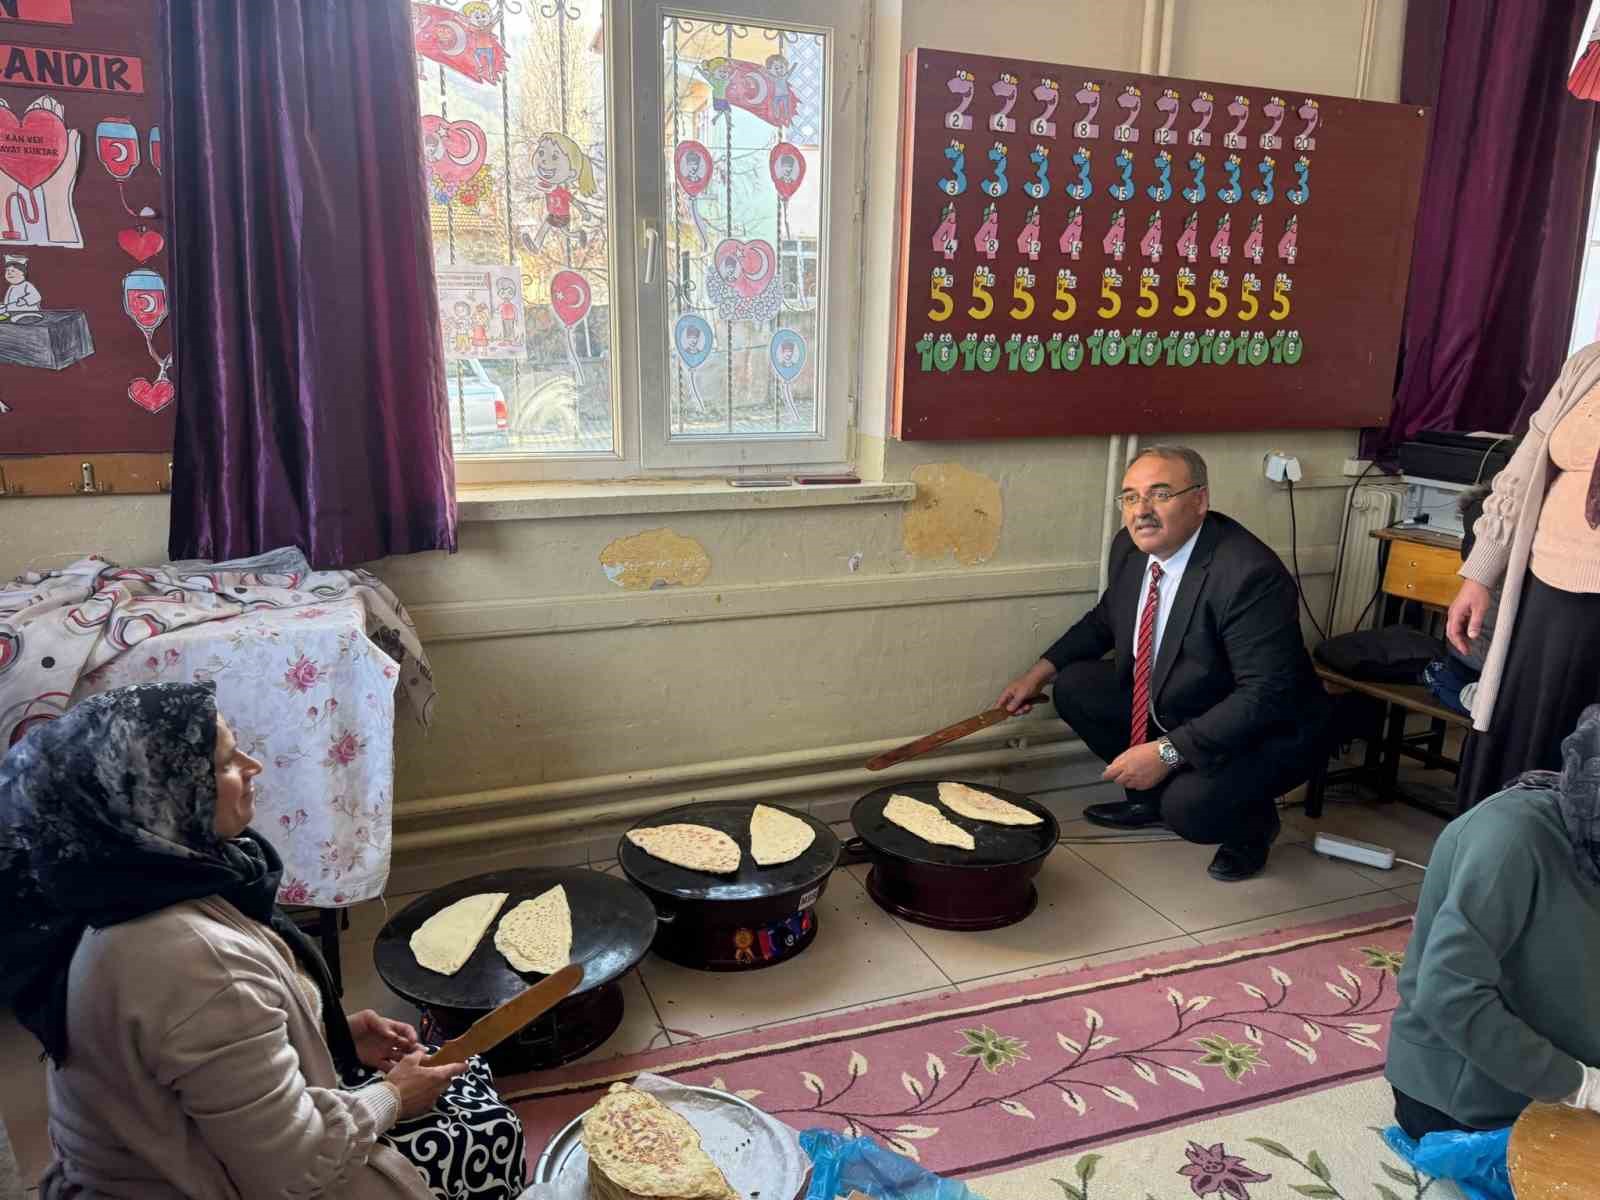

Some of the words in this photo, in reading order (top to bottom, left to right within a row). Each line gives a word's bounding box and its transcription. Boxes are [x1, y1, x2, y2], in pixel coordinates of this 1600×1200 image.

[0, 46, 131, 91] ANDIR
[952, 113, 960, 128] 2
[996, 115, 1005, 131] 4
[1036, 120, 1045, 134] 6
[1080, 123, 1088, 136] 8
[1118, 126, 1131, 140] 10
[1158, 130, 1170, 143] 12
[1190, 131, 1203, 144] 14
[1226, 134, 1237, 147] 16
